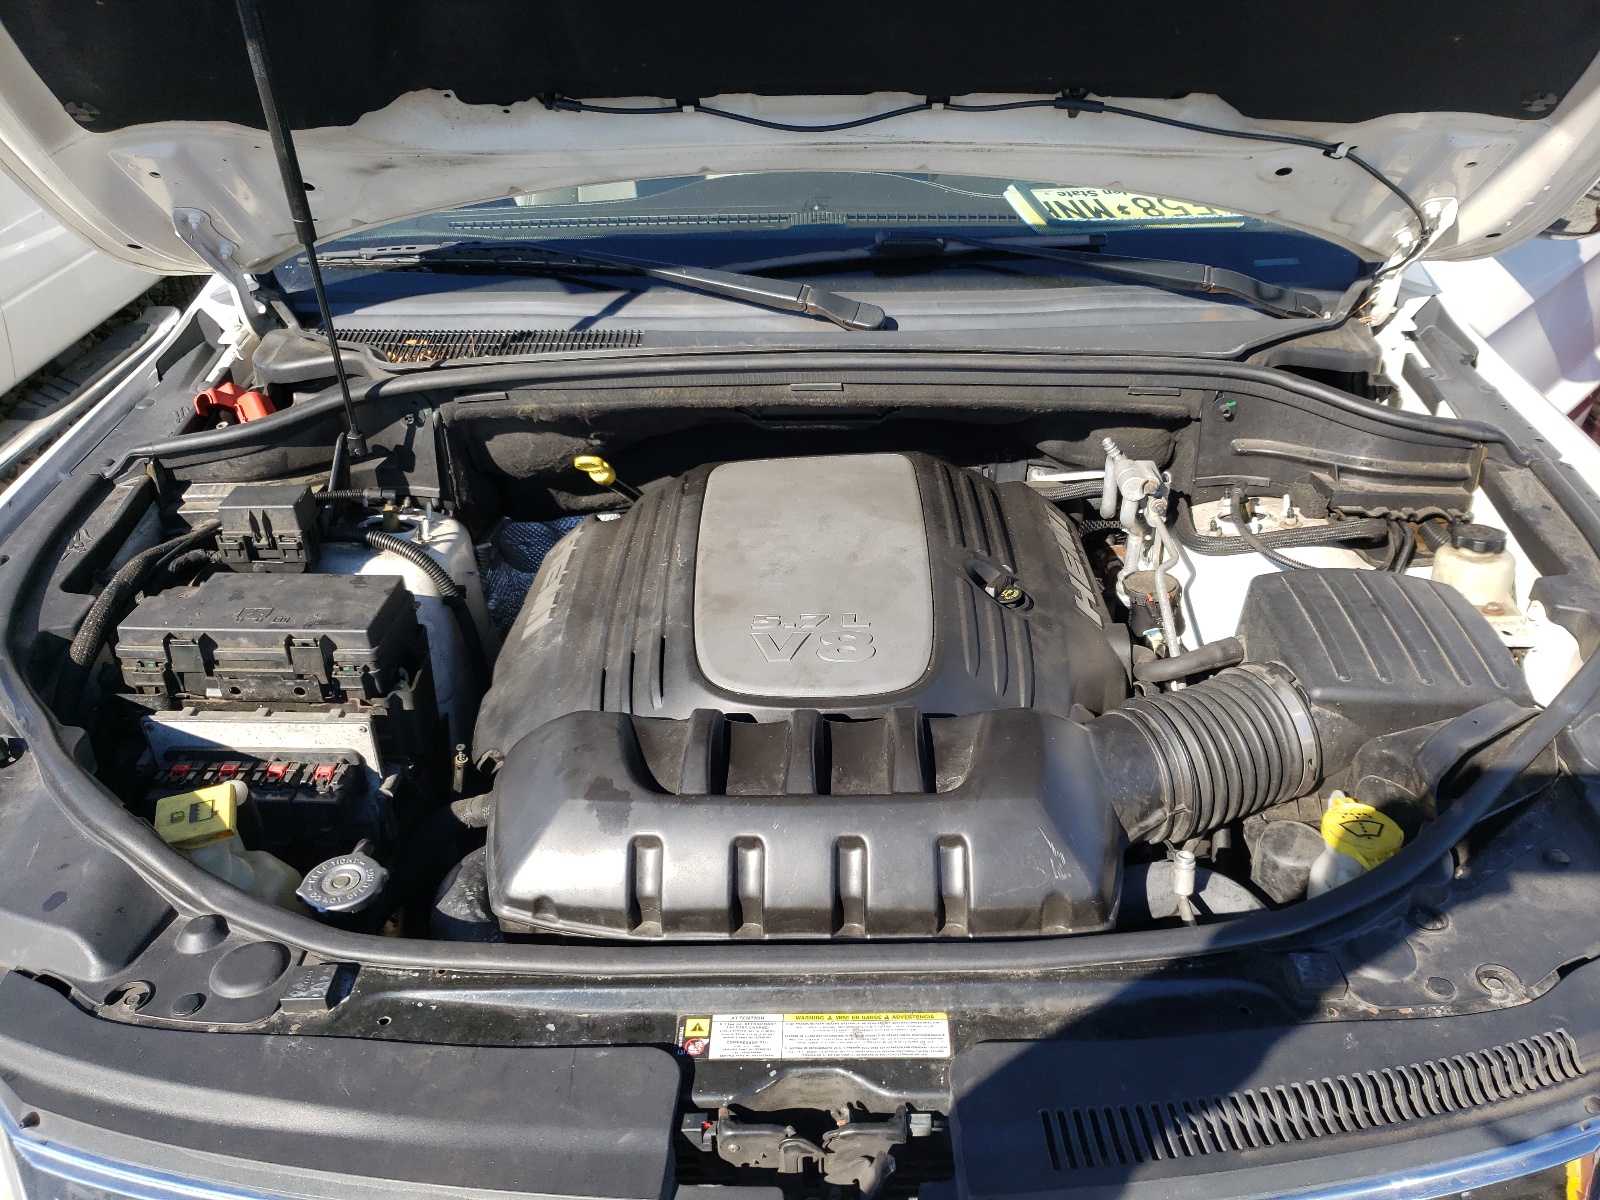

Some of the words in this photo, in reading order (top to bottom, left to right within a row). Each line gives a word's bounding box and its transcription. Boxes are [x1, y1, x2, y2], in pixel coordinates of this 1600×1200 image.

[1057, 190, 1098, 198] State
[1044, 504, 1103, 630] HEMI
[749, 630, 877, 662] V8
